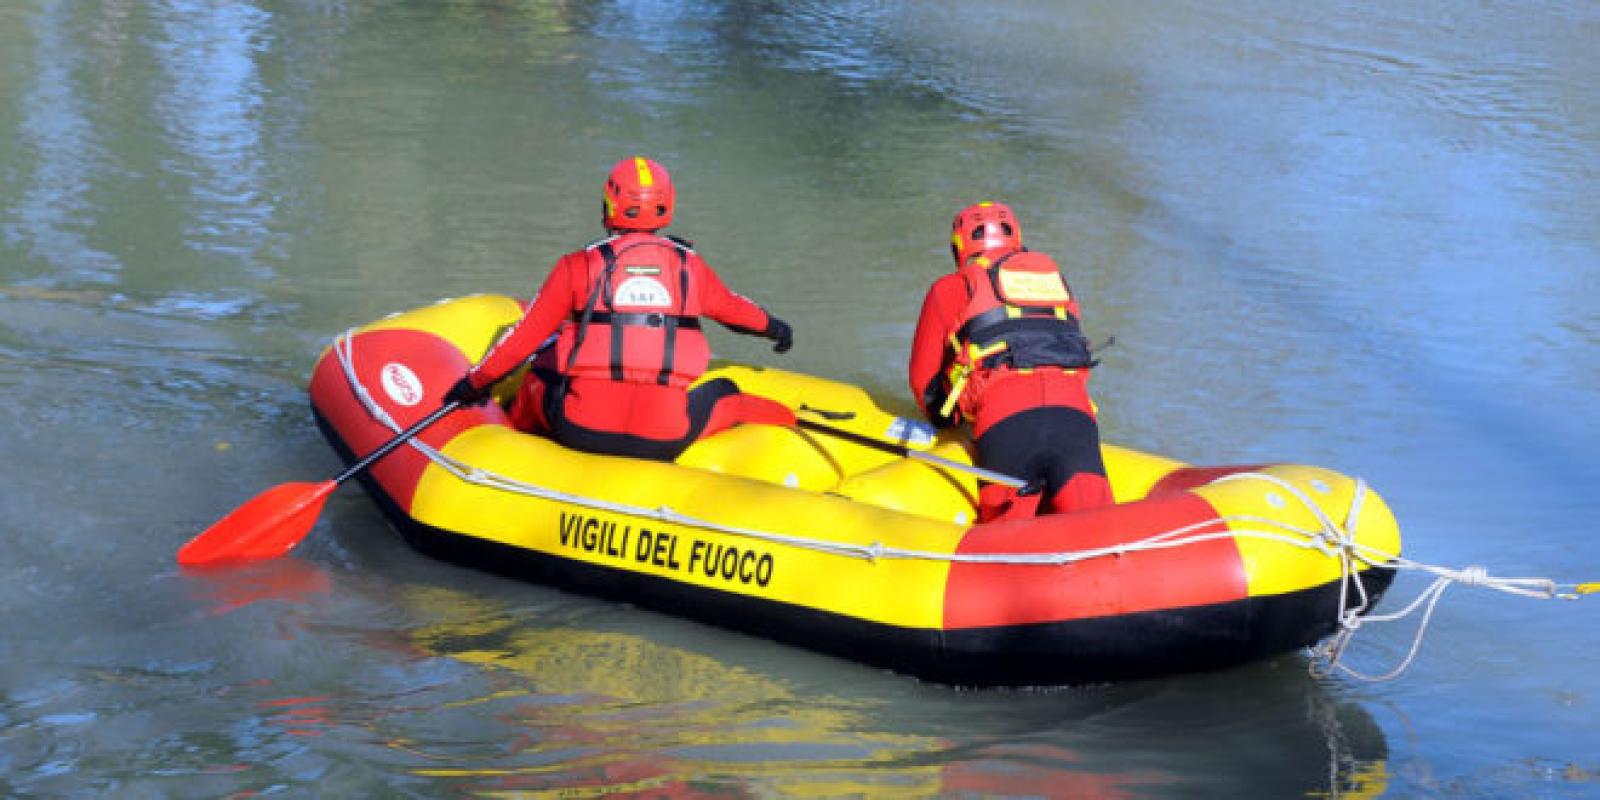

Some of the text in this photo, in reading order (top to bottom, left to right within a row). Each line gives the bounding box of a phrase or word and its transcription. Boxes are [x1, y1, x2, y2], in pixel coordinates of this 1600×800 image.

[560, 512, 774, 587] VIGILI DEL FUOCO
